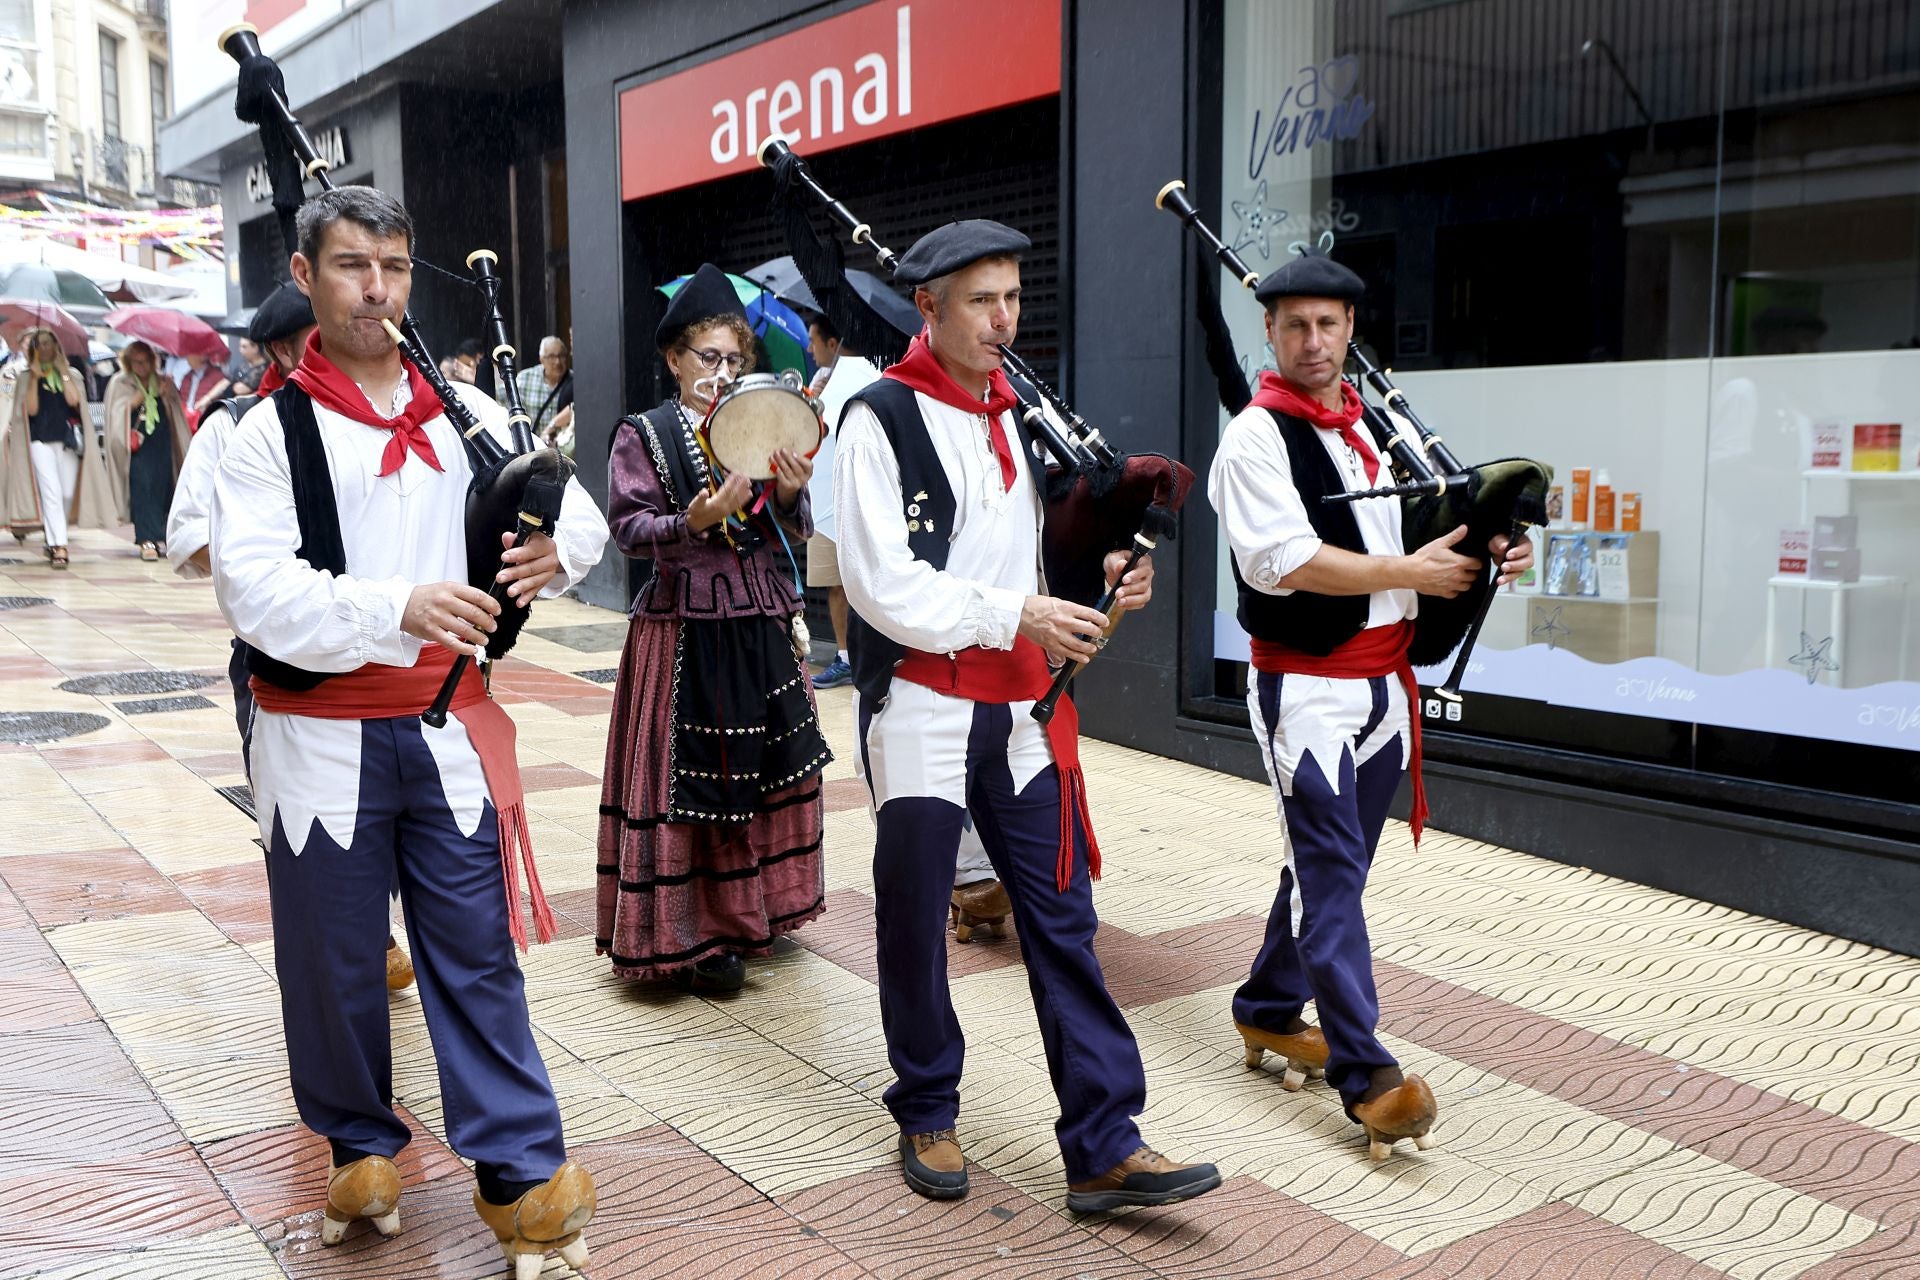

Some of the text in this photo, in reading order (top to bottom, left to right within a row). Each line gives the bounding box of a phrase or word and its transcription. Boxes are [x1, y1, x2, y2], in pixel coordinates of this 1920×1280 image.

[710, 5, 912, 164] arenal
[1296, 66, 1319, 108] a
[1249, 86, 1375, 181] Verano
[1615, 675, 1697, 702] a Verano
[1857, 703, 1874, 726] a
